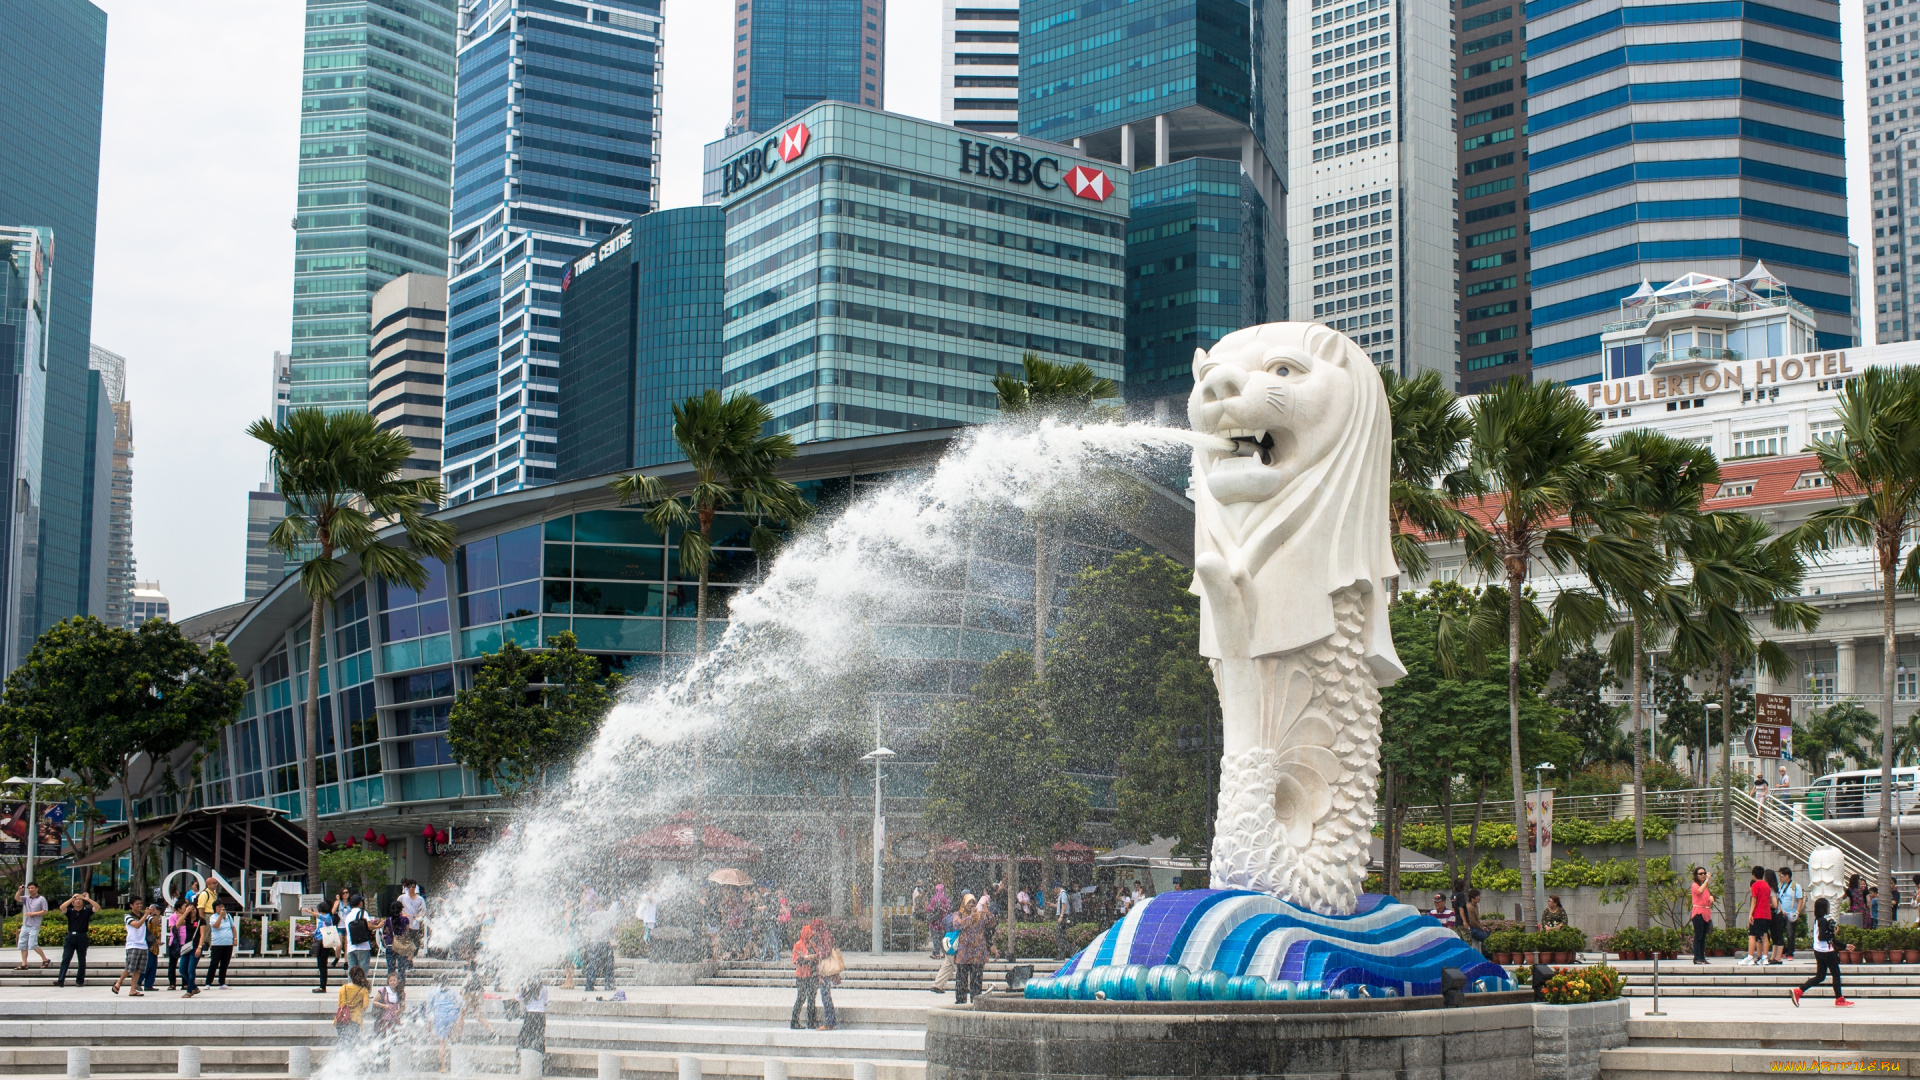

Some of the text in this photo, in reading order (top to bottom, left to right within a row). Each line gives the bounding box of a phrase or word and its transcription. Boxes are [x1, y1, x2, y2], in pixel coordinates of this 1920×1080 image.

[721, 137, 777, 197] HSBC
[959, 139, 1059, 190] HSBC
[574, 228, 633, 277] TUNG CENTRE
[1587, 365, 1743, 408] FULLERTON
[1756, 351, 1853, 384] HOTEL
[162, 868, 278, 910] ONE
